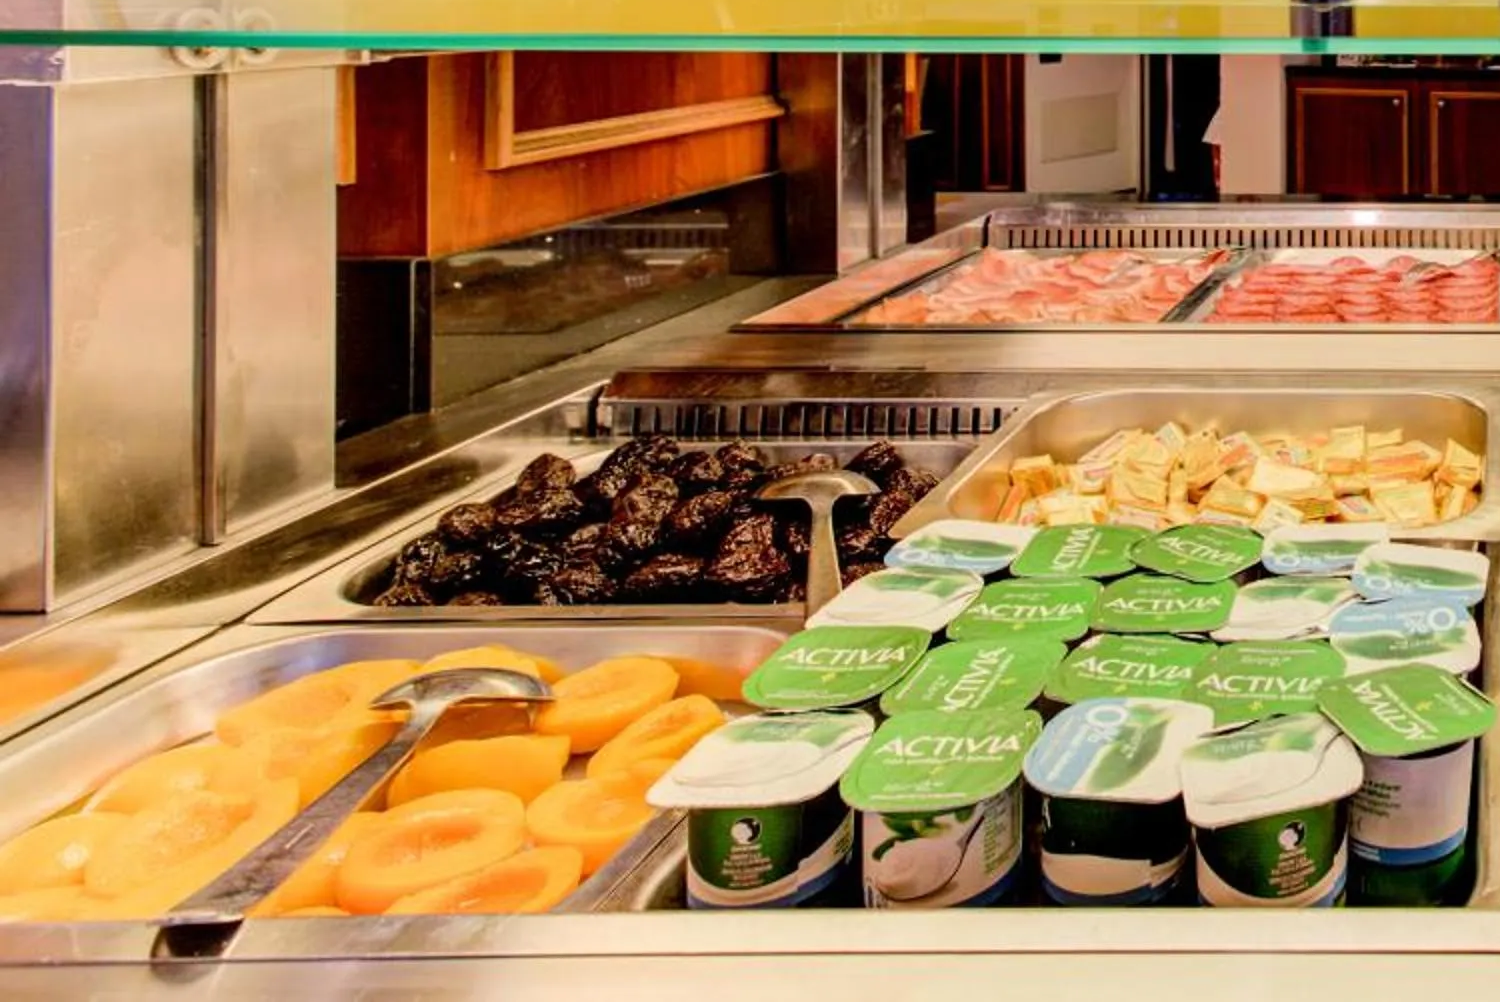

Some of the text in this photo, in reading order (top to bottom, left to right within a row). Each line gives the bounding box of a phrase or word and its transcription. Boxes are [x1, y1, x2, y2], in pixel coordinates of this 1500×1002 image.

[967, 602, 1086, 618] ACTIVIA
[1105, 596, 1222, 611] ACTIVIA
[779, 646, 909, 666] ACTIVIA
[1071, 656, 1193, 679] ACTIVIA
[875, 735, 1022, 757] ACTIVIA
